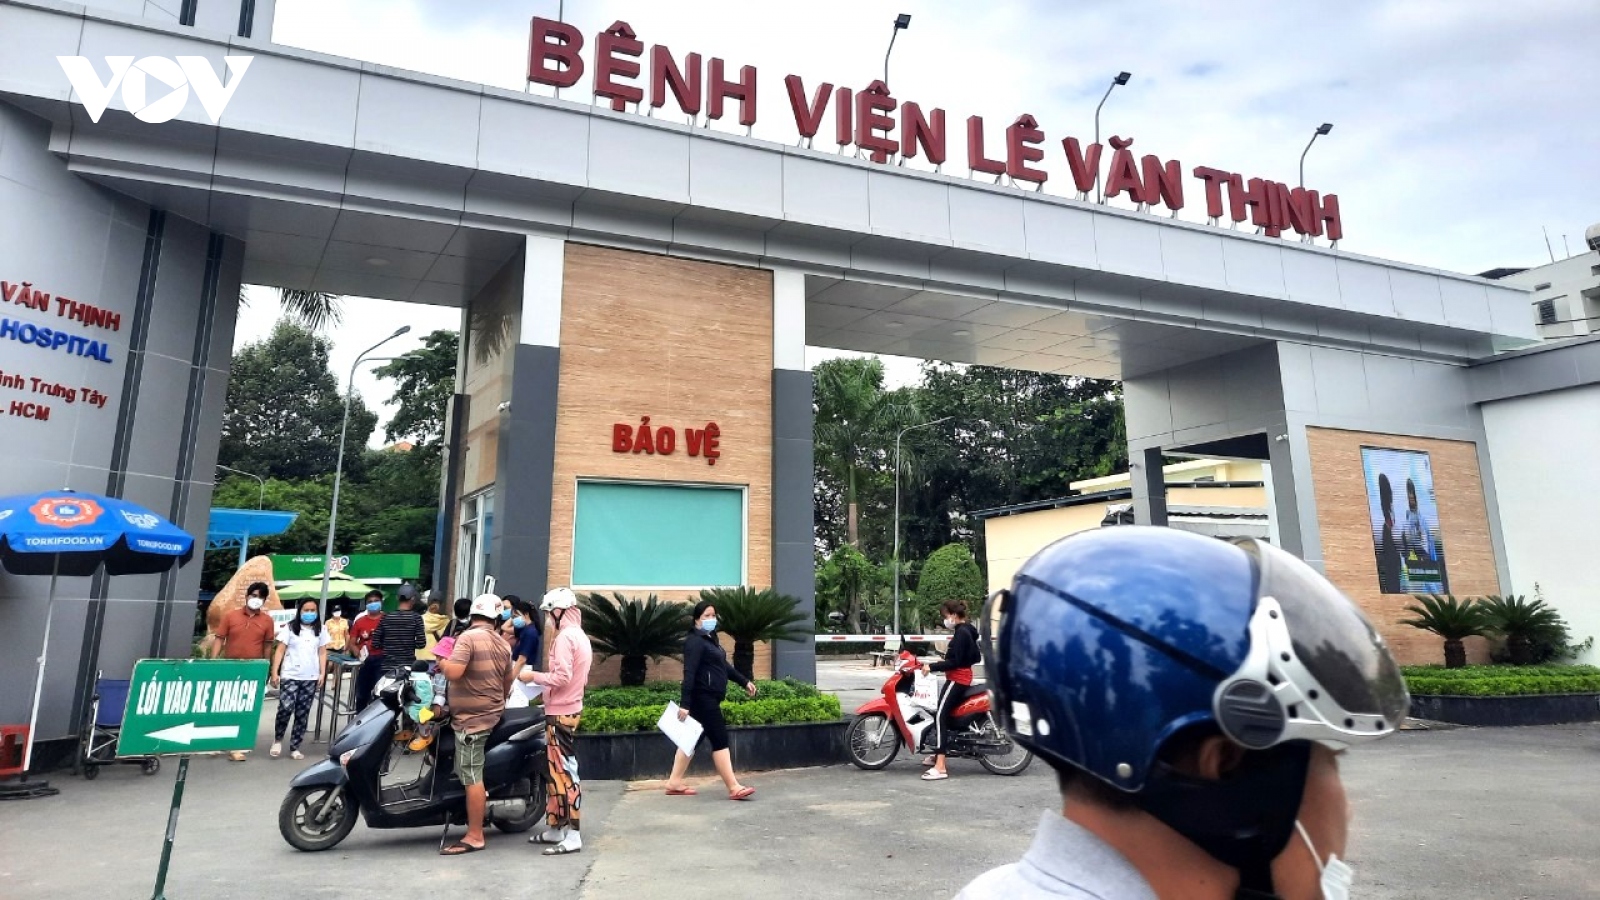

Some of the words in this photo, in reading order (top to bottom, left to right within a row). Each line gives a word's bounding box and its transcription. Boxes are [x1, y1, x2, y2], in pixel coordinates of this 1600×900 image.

[527, 16, 757, 126] BỆNH
[784, 74, 946, 165] VIỆN
[967, 113, 1048, 183] LÊ
[1062, 135, 1185, 211] VĂN
[1193, 165, 1343, 241] THỊNH
[0, 280, 51, 312] VĂN
[55, 296, 121, 332] THỊNH
[0, 318, 113, 364] HOSPITAL
[9, 400, 51, 421] HCM
[30, 377, 77, 404] Trưng
[81, 387, 109, 409] Tây
[612, 415, 676, 456] BẢO
[684, 421, 721, 466] VỆ
[25, 536, 104, 546] TORKIFOOD.VN
[135, 669, 163, 716] LỐI
[162, 675, 193, 715] VÀO
[191, 680, 212, 714] XE
[210, 674, 259, 713] KHÁCH
